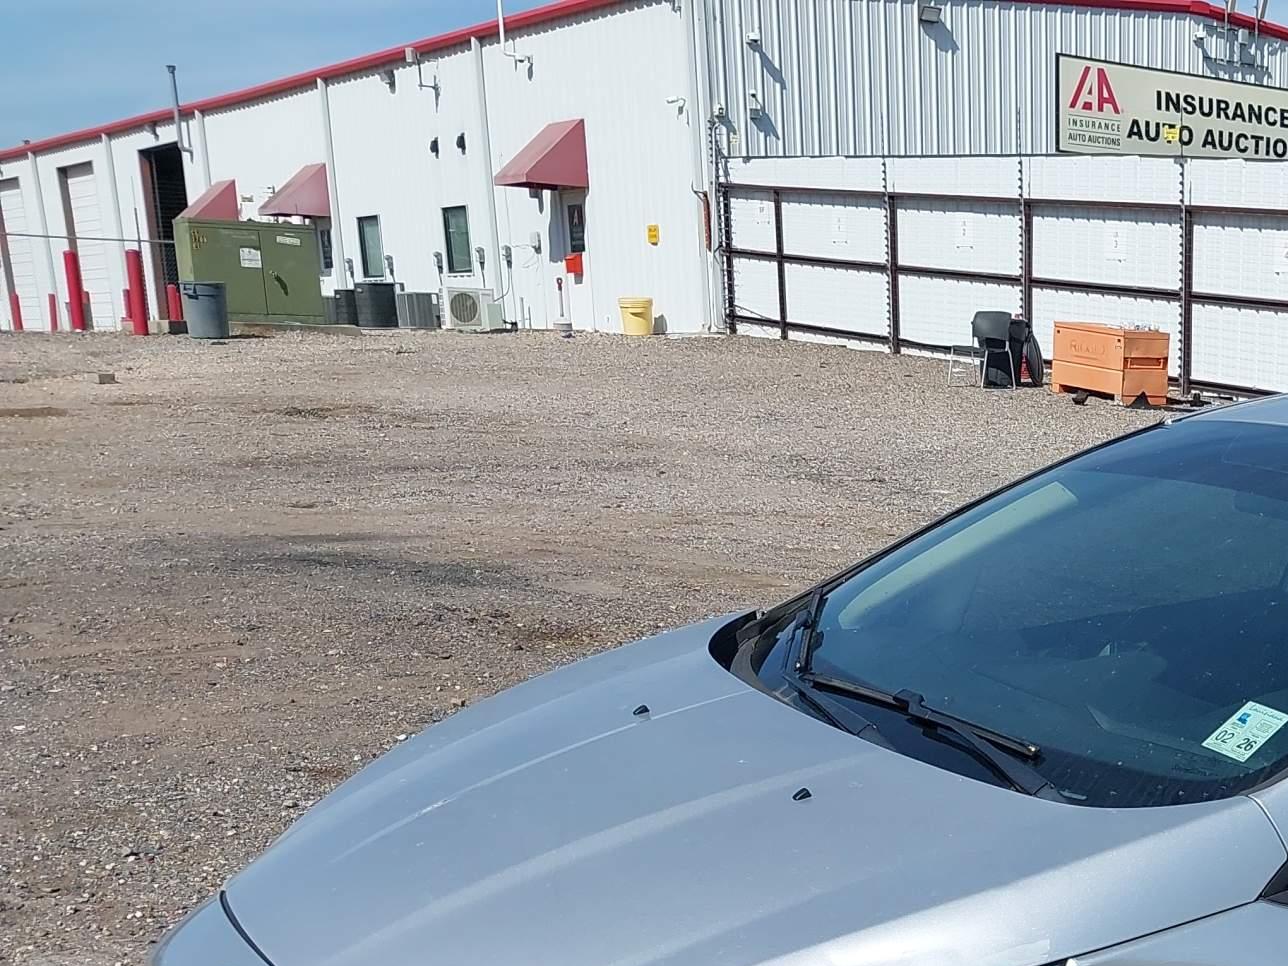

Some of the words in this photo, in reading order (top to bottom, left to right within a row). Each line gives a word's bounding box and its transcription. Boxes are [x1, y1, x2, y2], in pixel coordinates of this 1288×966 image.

[1068, 117, 1121, 132] INSURANCE
[1068, 132, 1086, 143] AUTO
[1087, 134, 1121, 147] AUCTIONS
[1215, 729, 1235, 744] 02
[1236, 737, 1257, 752] 26
